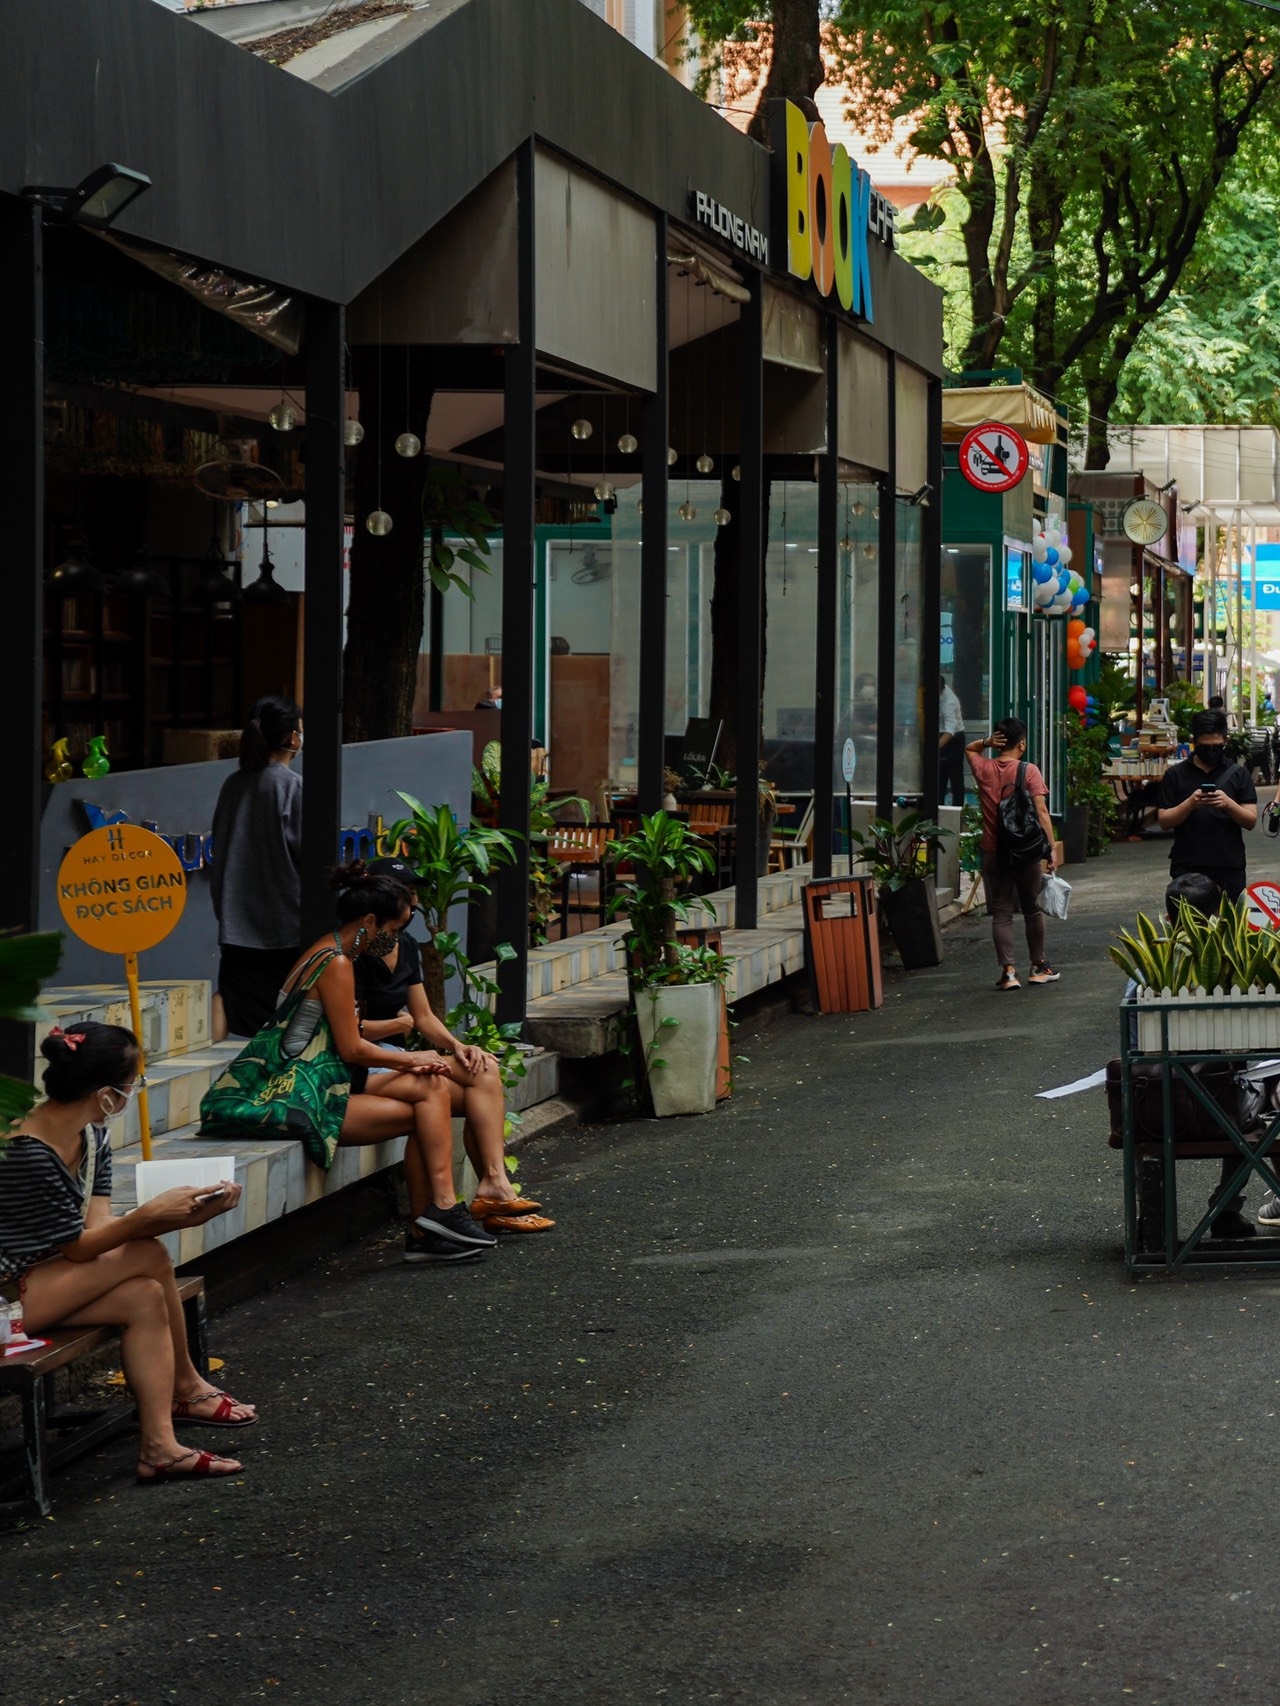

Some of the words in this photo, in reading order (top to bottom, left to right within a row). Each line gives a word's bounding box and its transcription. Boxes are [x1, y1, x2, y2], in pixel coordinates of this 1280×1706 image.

[786, 98, 874, 325] BOOK
[83, 855, 106, 865] HAY
[61, 877, 131, 899] KHÔNG
[136, 872, 183, 891] GIAN
[75, 901, 117, 921] ĐỌC
[123, 894, 173, 915] SÁCH
